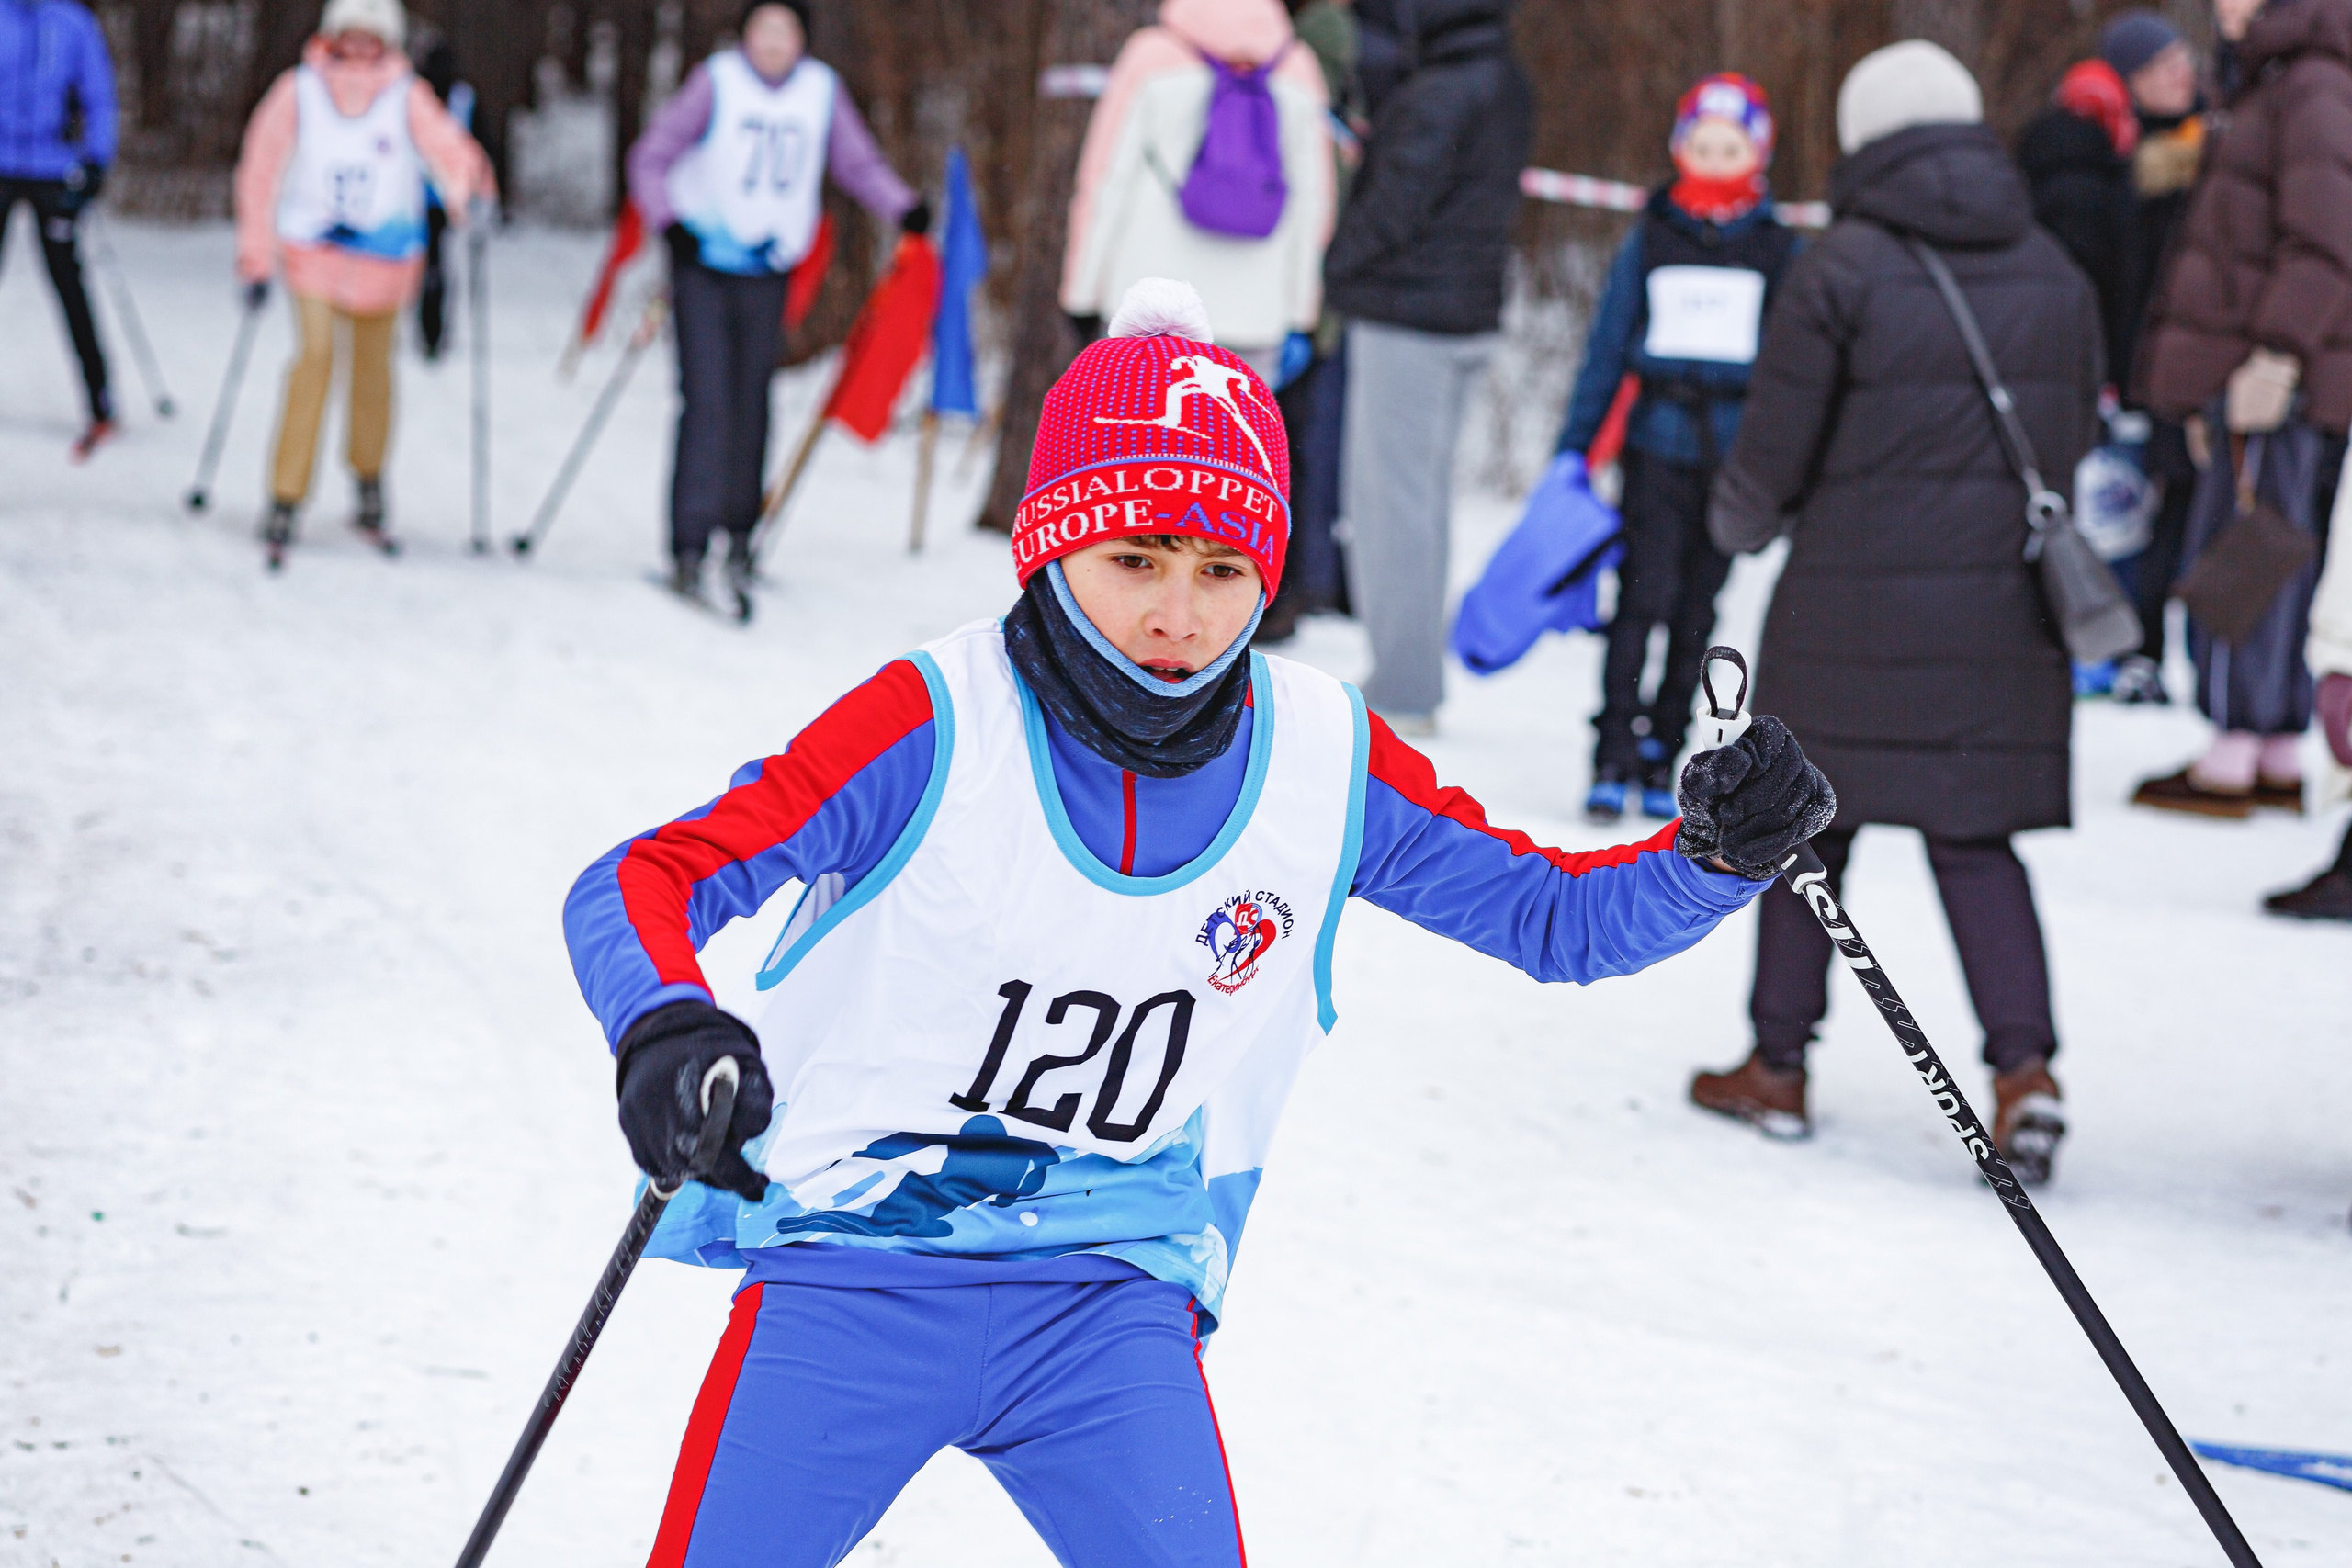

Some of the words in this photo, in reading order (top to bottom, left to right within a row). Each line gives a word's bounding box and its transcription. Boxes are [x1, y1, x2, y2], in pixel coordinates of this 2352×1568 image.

[739, 113, 808, 197] 70
[1012, 468, 1278, 538] RUSSIALOPPET
[1195, 889, 1251, 946] ДЕТСКИЙ
[1255, 890, 1294, 939] СТАДИОН
[948, 979, 1197, 1143] 120
